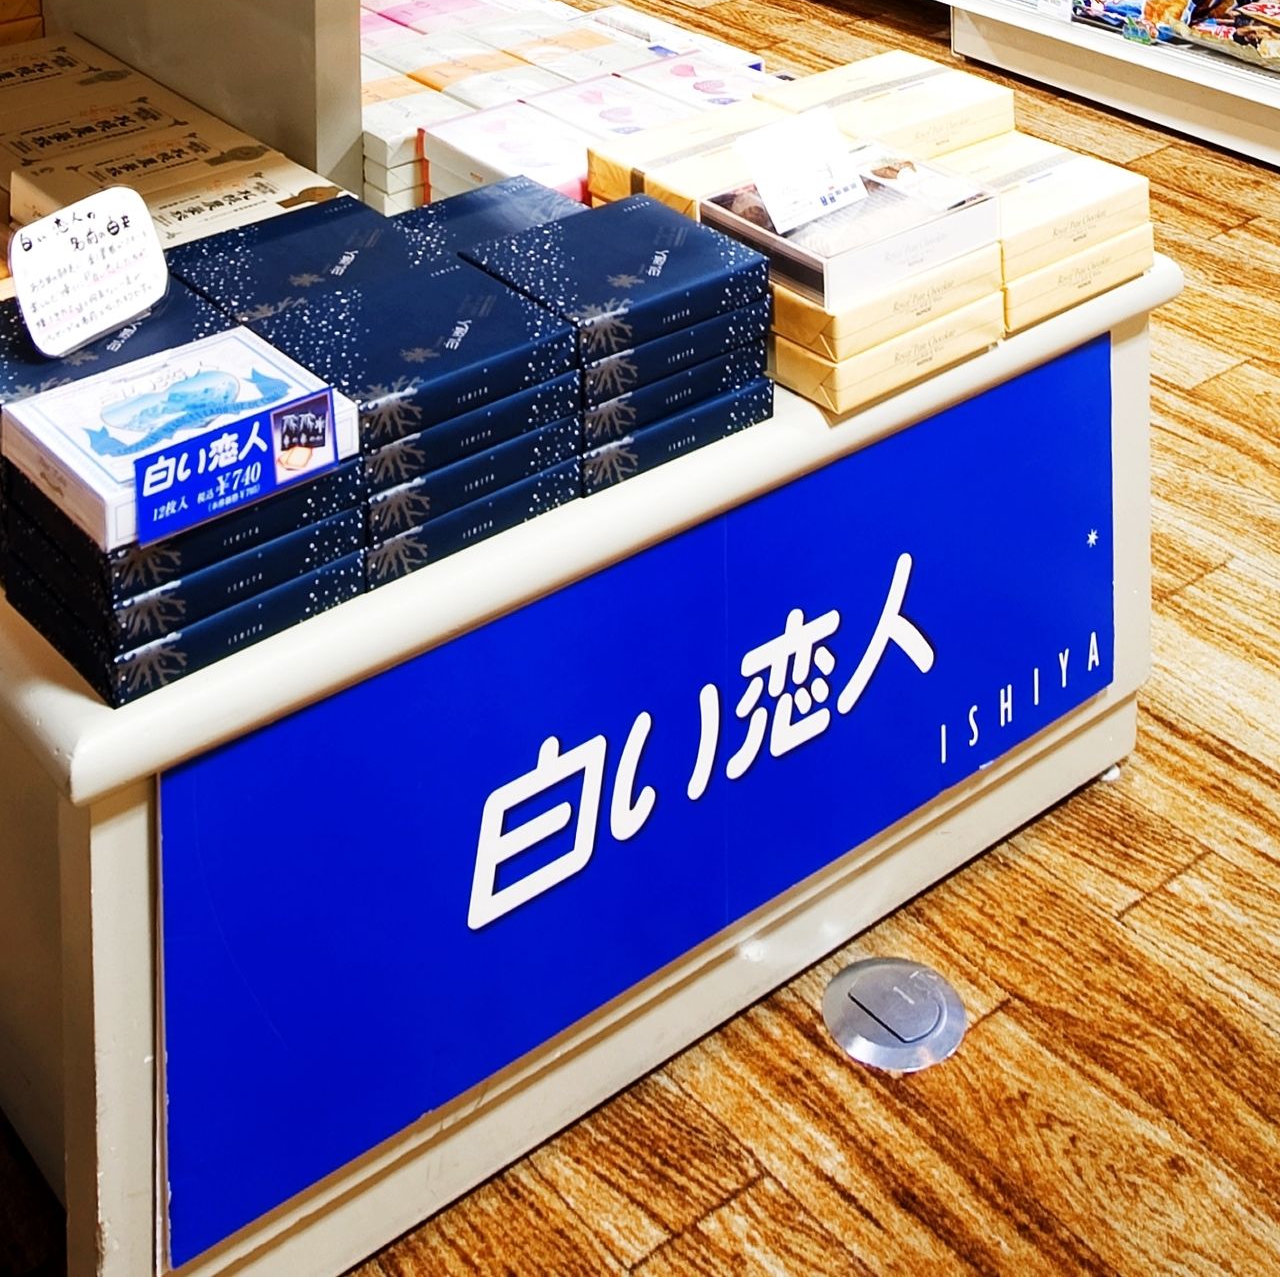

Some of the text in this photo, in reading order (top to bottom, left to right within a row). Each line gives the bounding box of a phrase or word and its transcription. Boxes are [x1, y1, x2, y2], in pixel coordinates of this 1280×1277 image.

[142, 421, 269, 497] 白い恋人
[152, 461, 262, 523] 12枚入 税込 ¥740
[466, 551, 935, 930] 白い恋人
[938, 631, 1102, 764] ISHIYA
